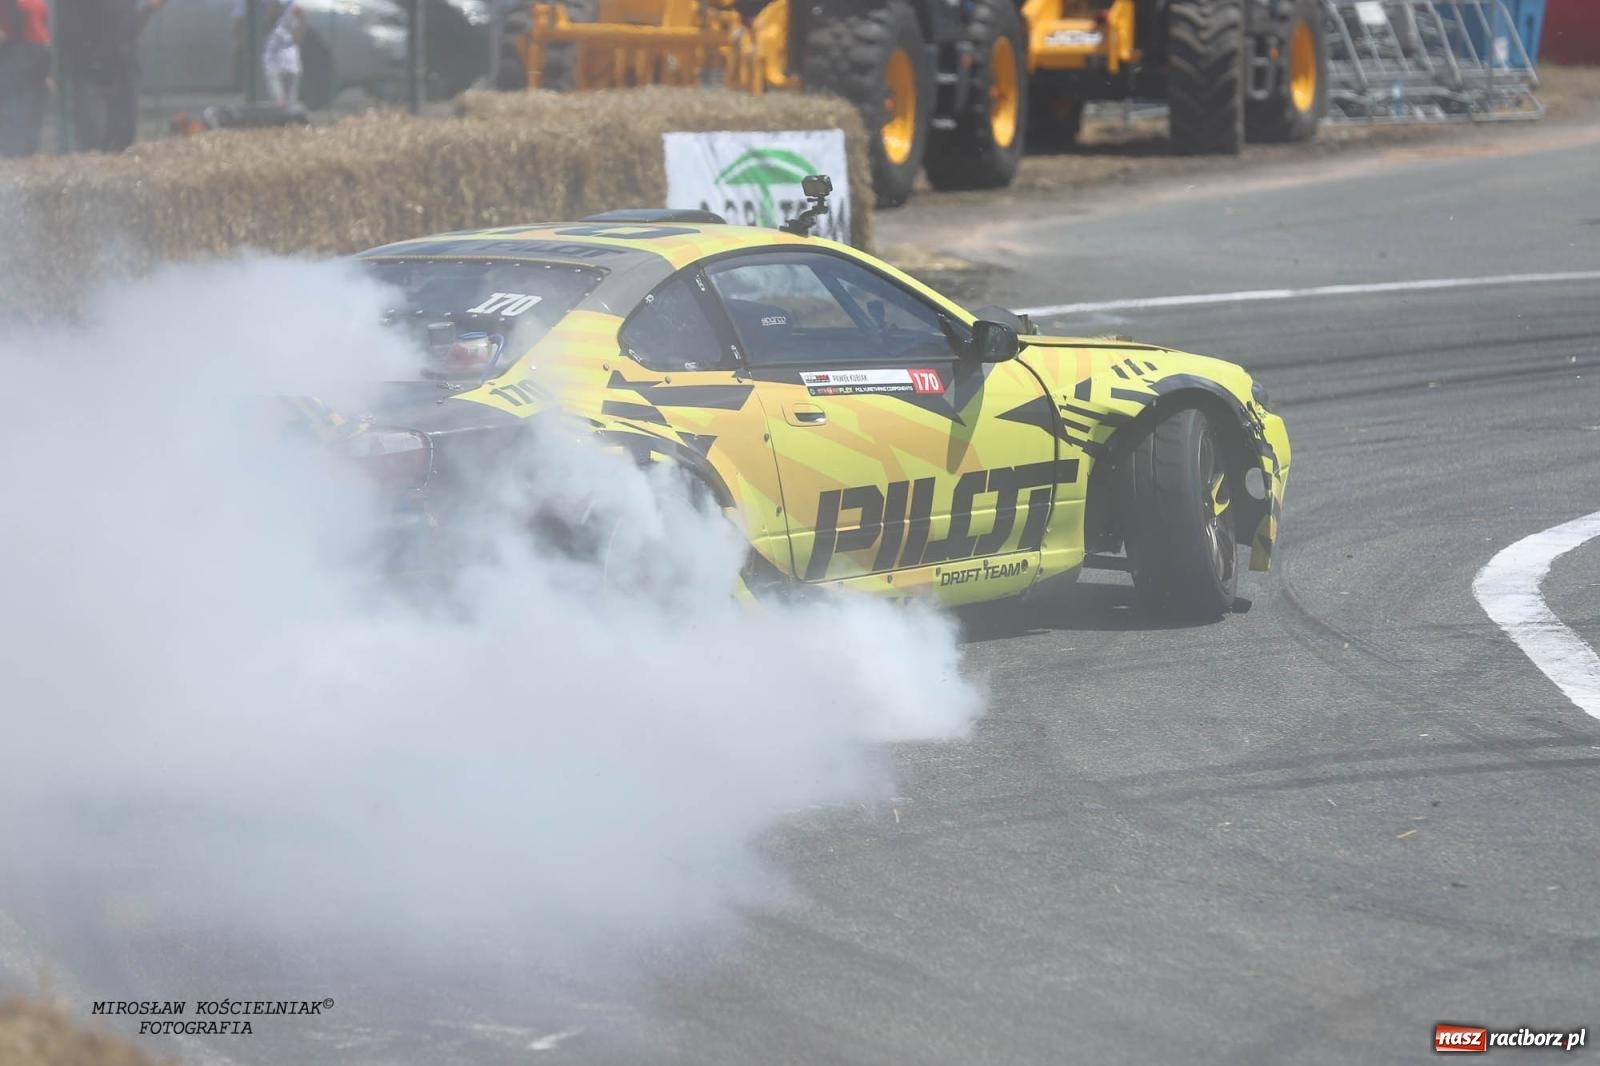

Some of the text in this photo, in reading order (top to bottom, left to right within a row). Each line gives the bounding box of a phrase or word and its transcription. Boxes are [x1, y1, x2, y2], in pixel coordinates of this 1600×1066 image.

[466, 292, 543, 317] 170
[914, 372, 939, 391] 170
[804, 458, 1080, 580] PILOT
[940, 562, 1021, 586] DRIFT TEAM
